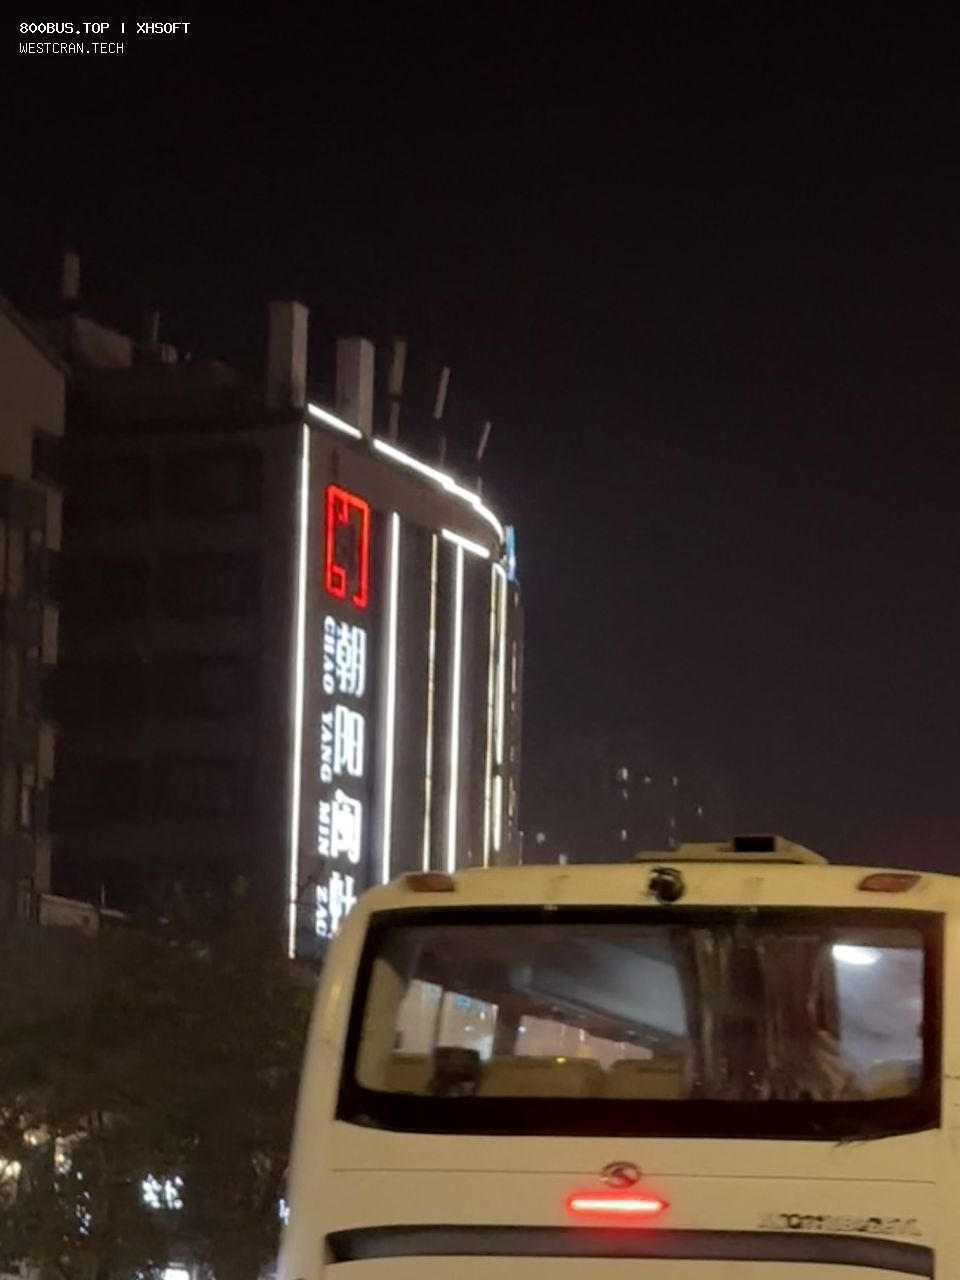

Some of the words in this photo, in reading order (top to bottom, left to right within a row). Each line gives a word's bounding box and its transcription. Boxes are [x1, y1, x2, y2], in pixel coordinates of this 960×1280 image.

[323, 615, 336, 695] CHAO
[320, 710, 333, 783] YANG
[318, 799, 331, 858] MIN
